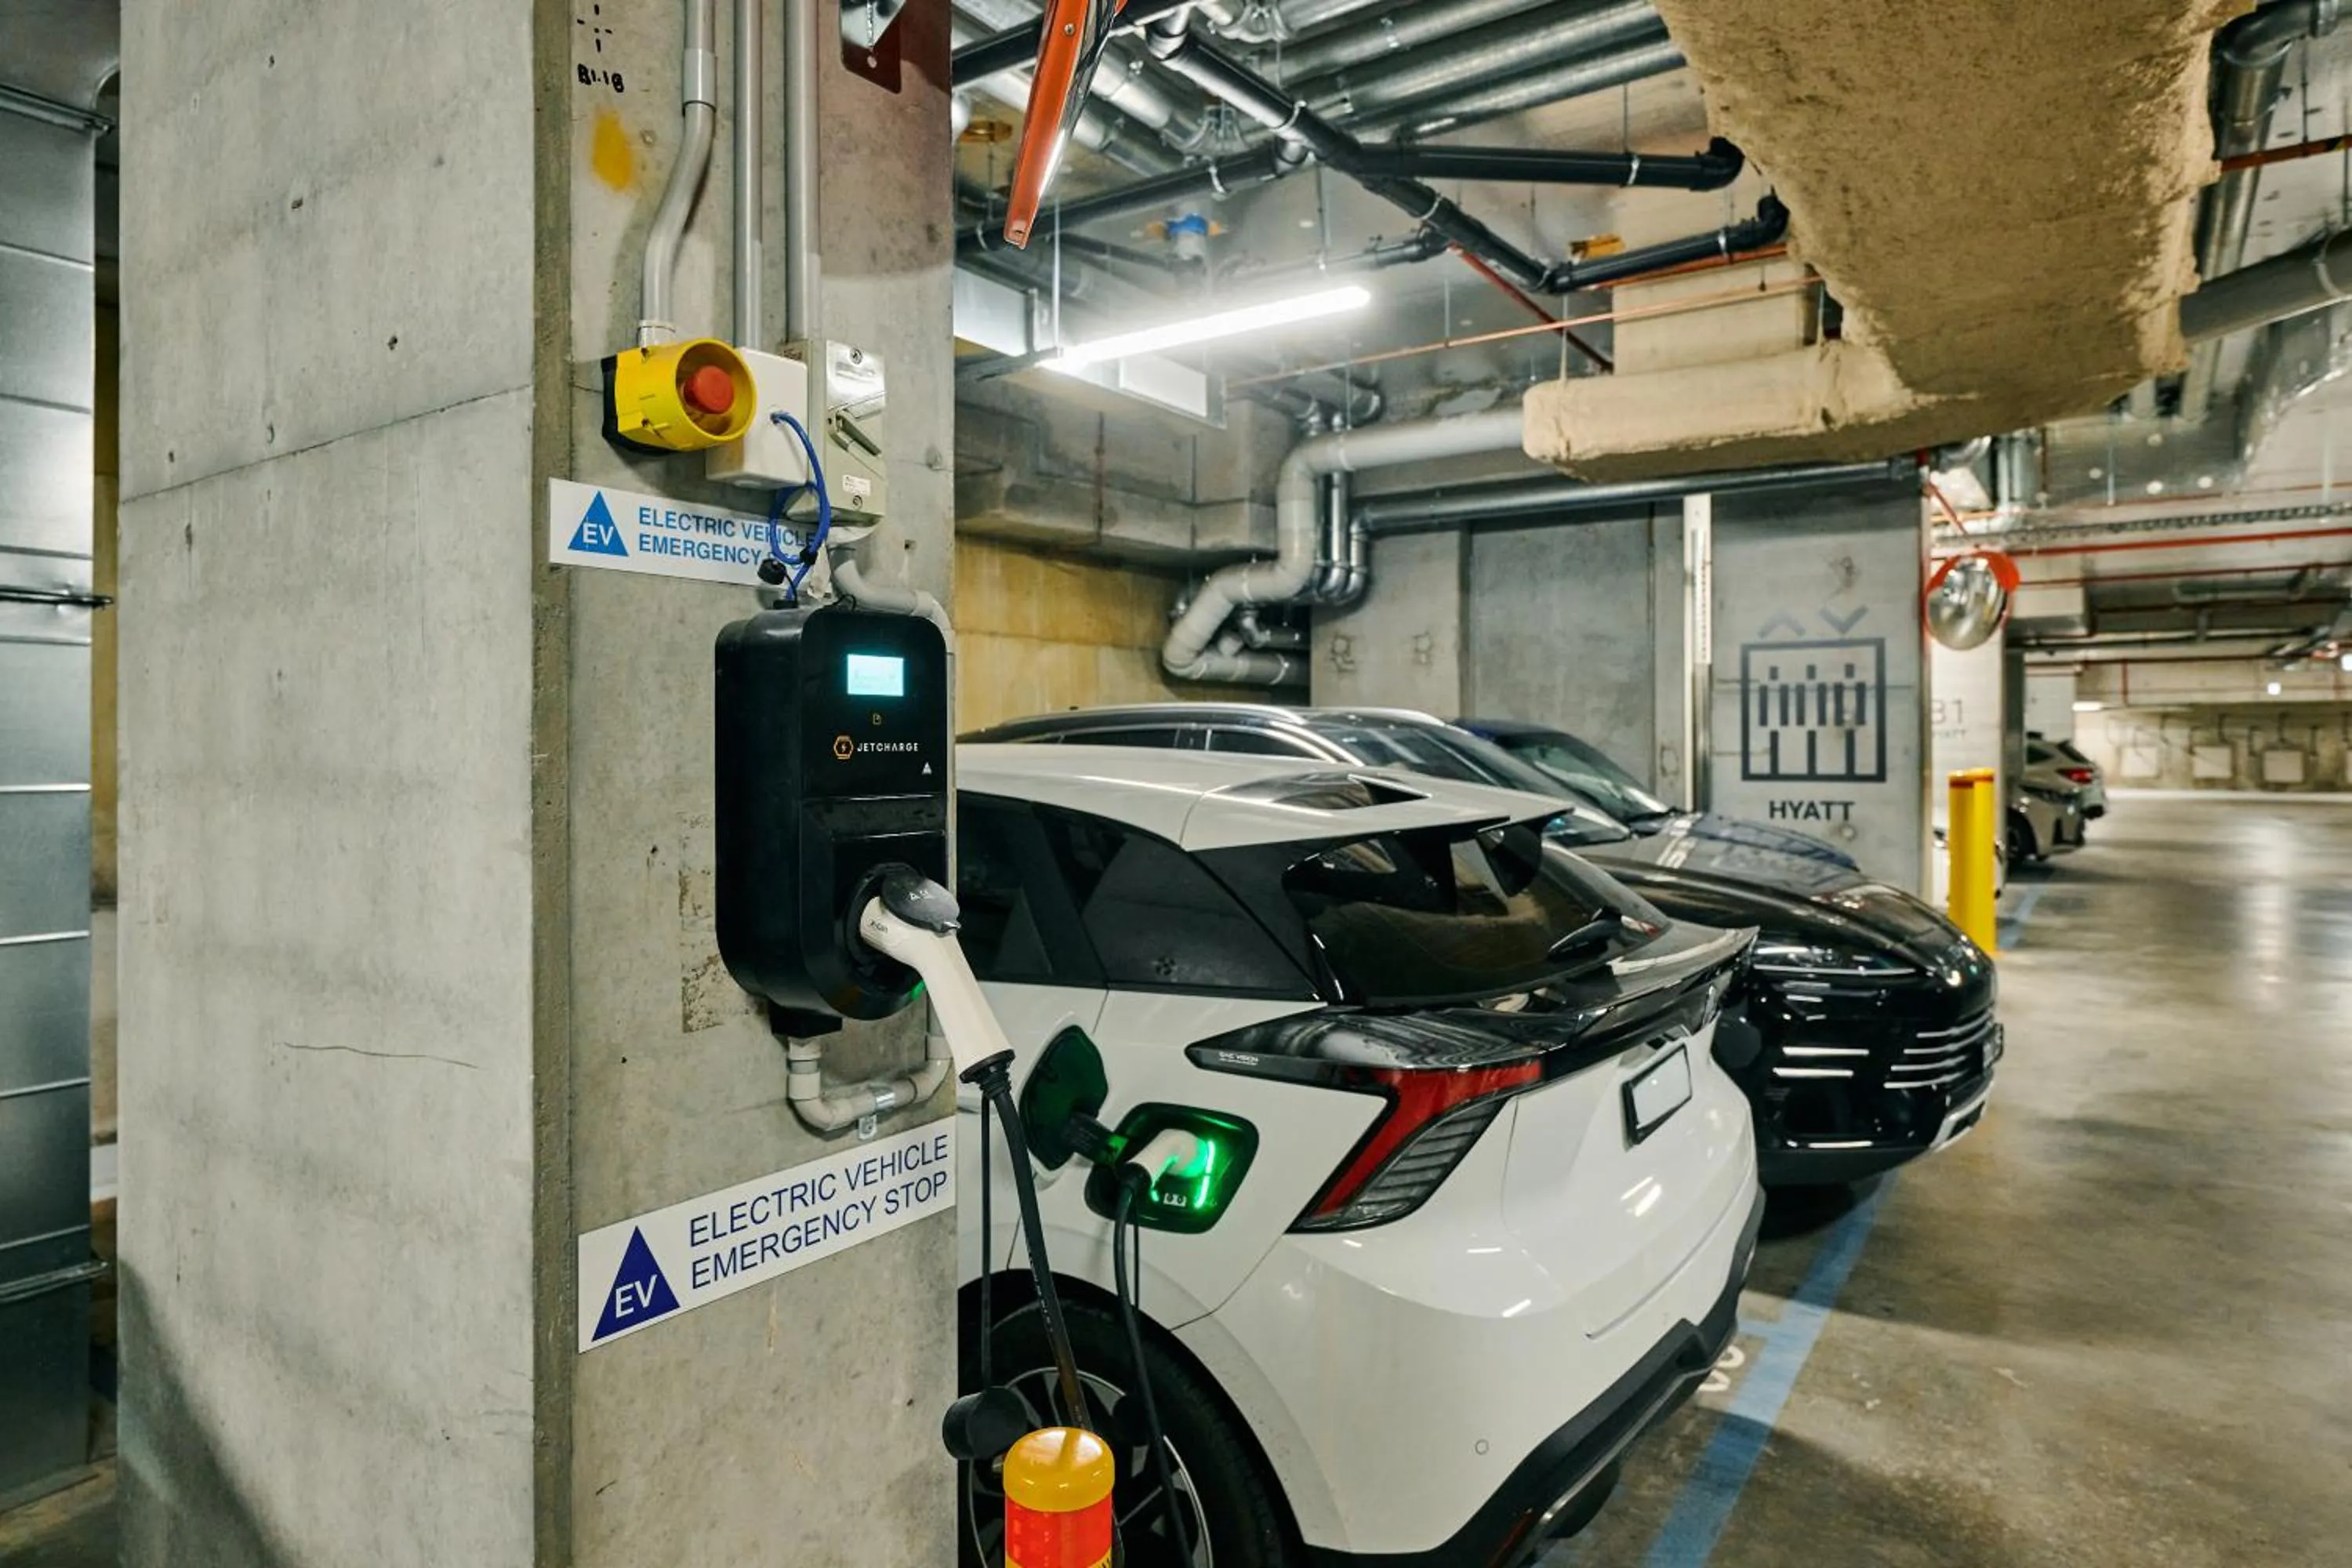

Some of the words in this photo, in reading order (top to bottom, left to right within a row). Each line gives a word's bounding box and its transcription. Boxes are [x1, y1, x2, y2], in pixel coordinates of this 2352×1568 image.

[582, 522, 615, 546] EV
[638, 506, 736, 537] ELECTRIC
[638, 533, 762, 565] EMERGENCY
[856, 742, 919, 753] JETCHARGE
[1769, 800, 1856, 821] HYATT
[689, 1173, 837, 1247] ELECTRIC
[844, 1134, 949, 1192] VEHICLE
[691, 1196, 877, 1290] EMERGENCY
[884, 1171, 948, 1215] STOP
[615, 1274, 657, 1319] EV
